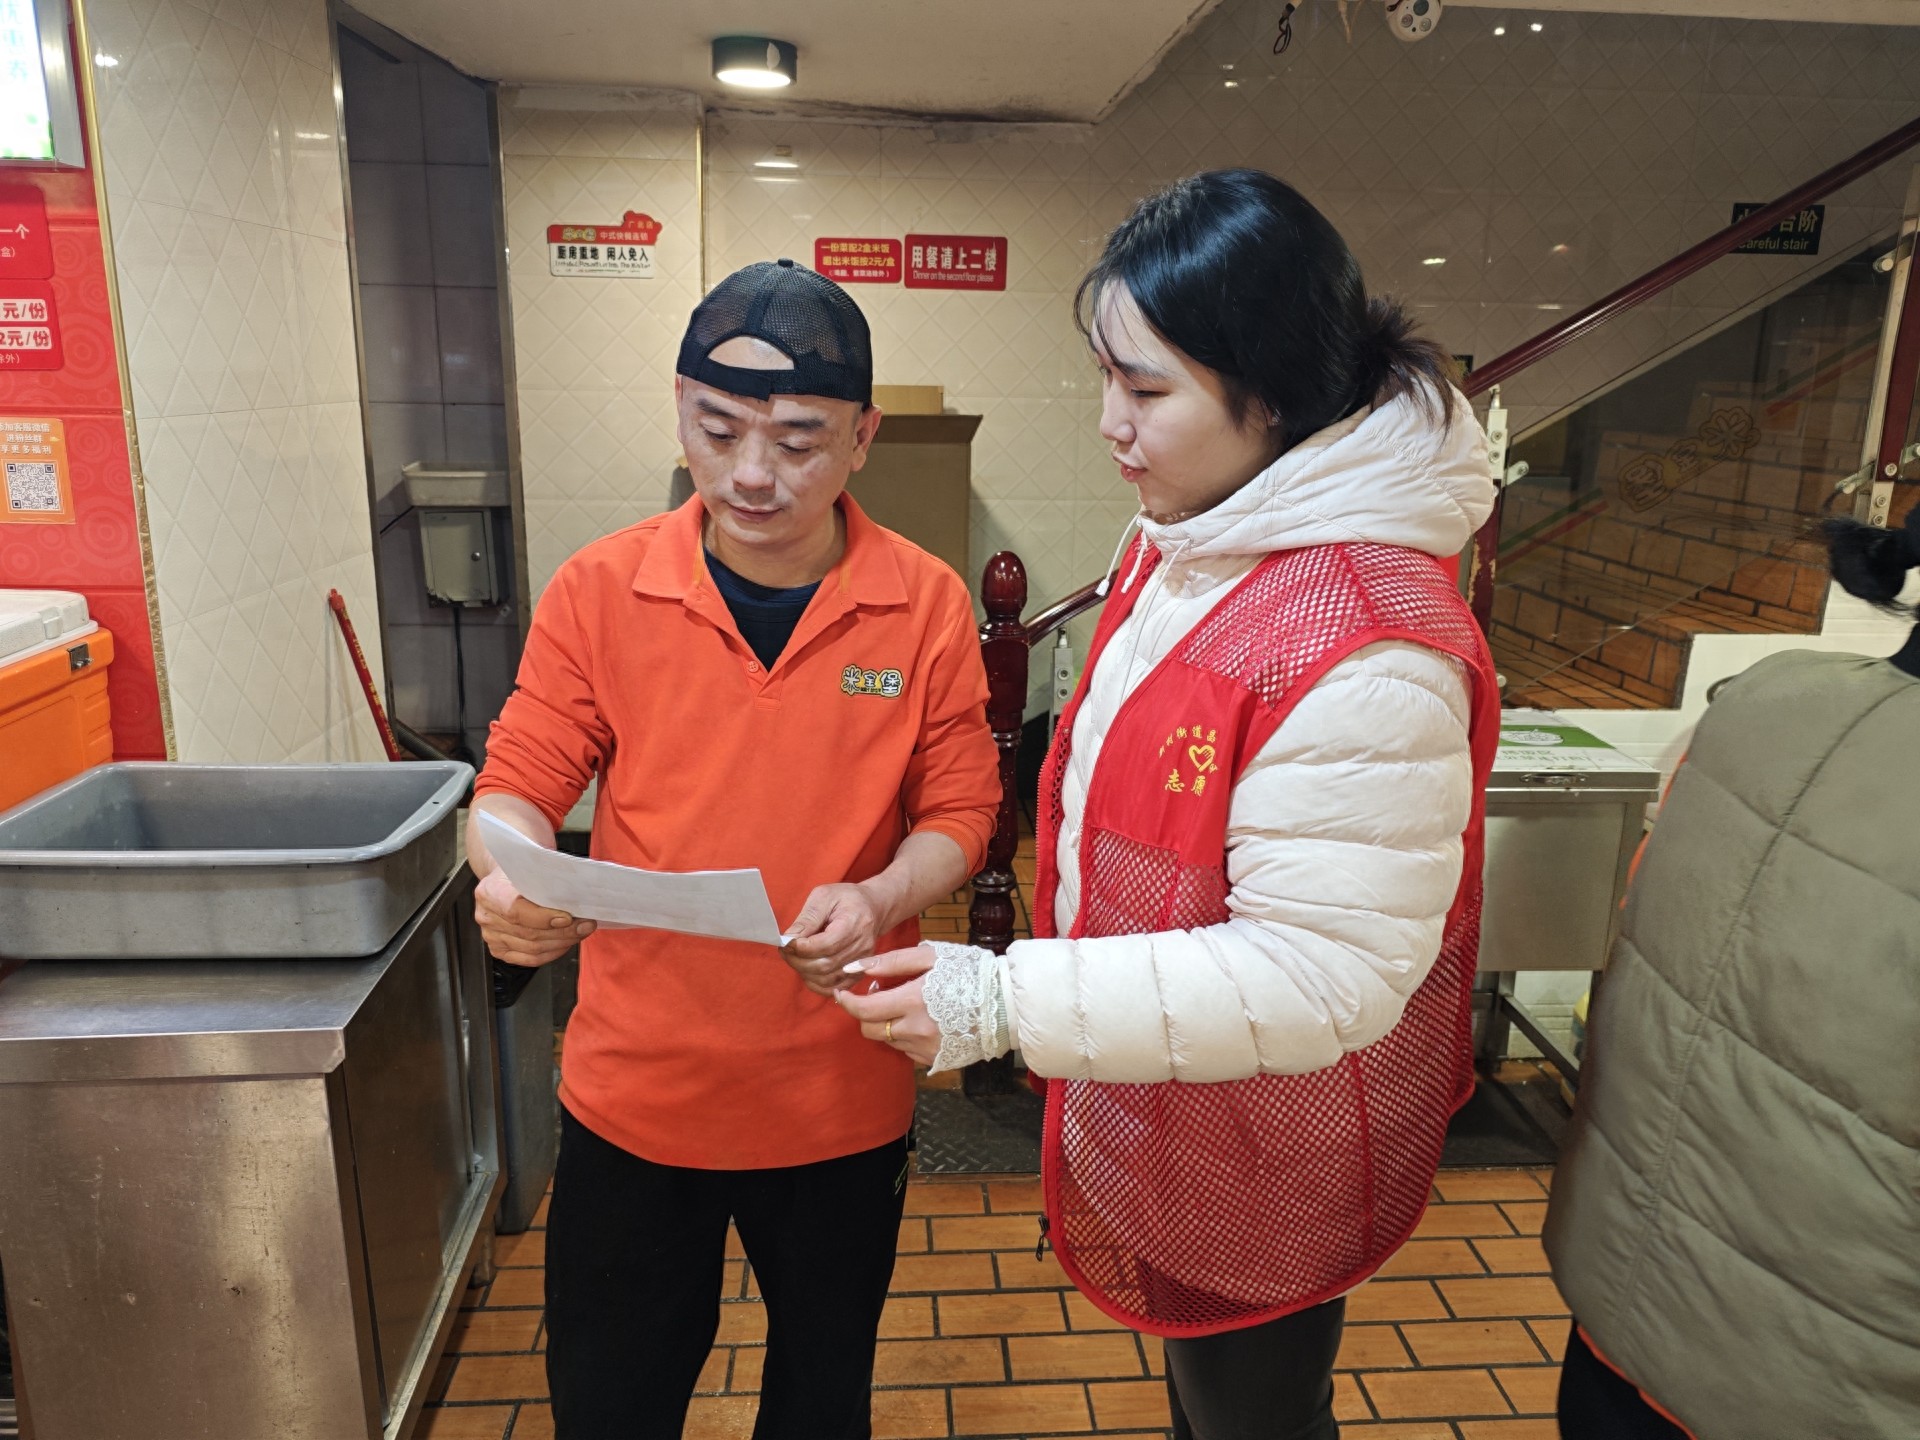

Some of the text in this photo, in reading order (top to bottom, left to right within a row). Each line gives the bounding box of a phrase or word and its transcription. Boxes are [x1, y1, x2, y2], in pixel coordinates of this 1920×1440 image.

[1782, 238, 1809, 250] stair
[557, 245, 649, 262] 厨房重地 闲人免入
[911, 244, 997, 271] 用餐请上二楼
